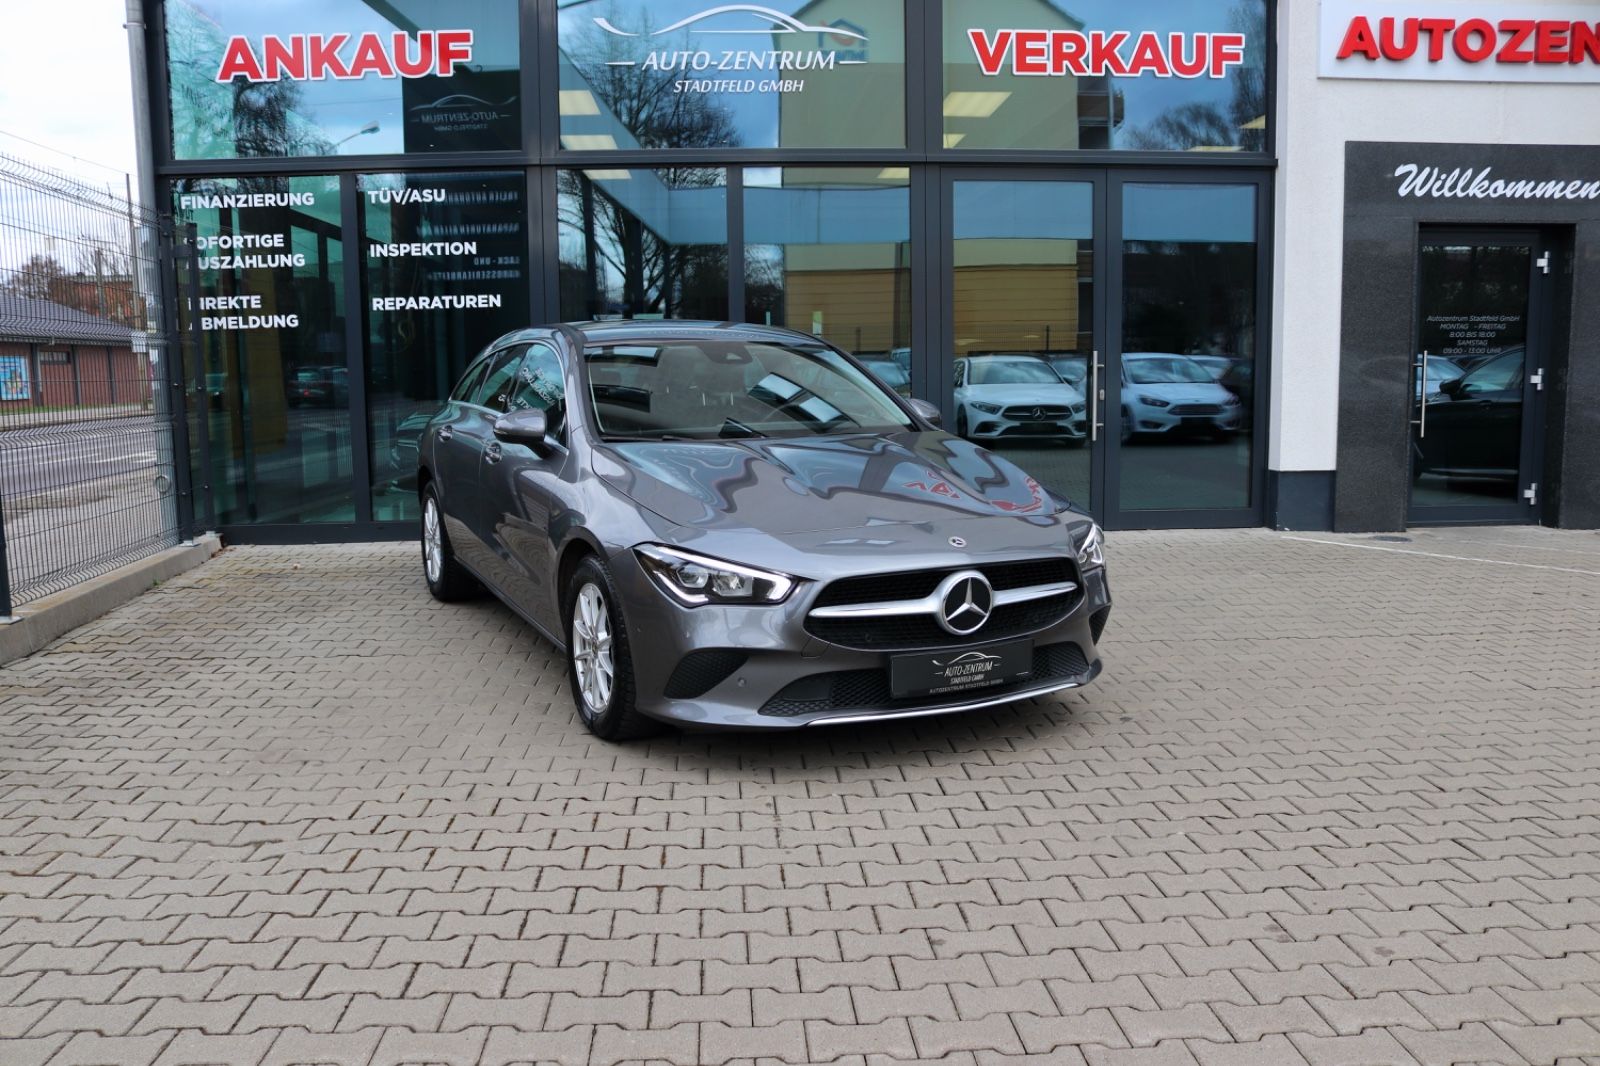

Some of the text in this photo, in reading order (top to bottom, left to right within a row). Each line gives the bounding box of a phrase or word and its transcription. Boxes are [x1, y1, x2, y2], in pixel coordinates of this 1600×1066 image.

[1336, 16, 1600, 65] AUTOZEN
[217, 30, 473, 82] ANKAUF
[641, 50, 837, 71] AUTO-ZENTRUM
[967, 28, 1246, 78] VERKAUF
[673, 79, 804, 93] STADTFELD GMBH
[1394, 163, 1600, 200] Willkommen
[180, 192, 315, 209] FINANZIERUNG
[368, 188, 446, 205] TÜV/ASU
[183, 234, 285, 250] OFORTIGE
[370, 241, 477, 258] INSPEKTION
[185, 253, 306, 270] USZAHLUNG
[187, 295, 262, 310] IREKTE
[372, 294, 502, 311] REPARATUREN
[188, 314, 299, 331] BMELDUNG
